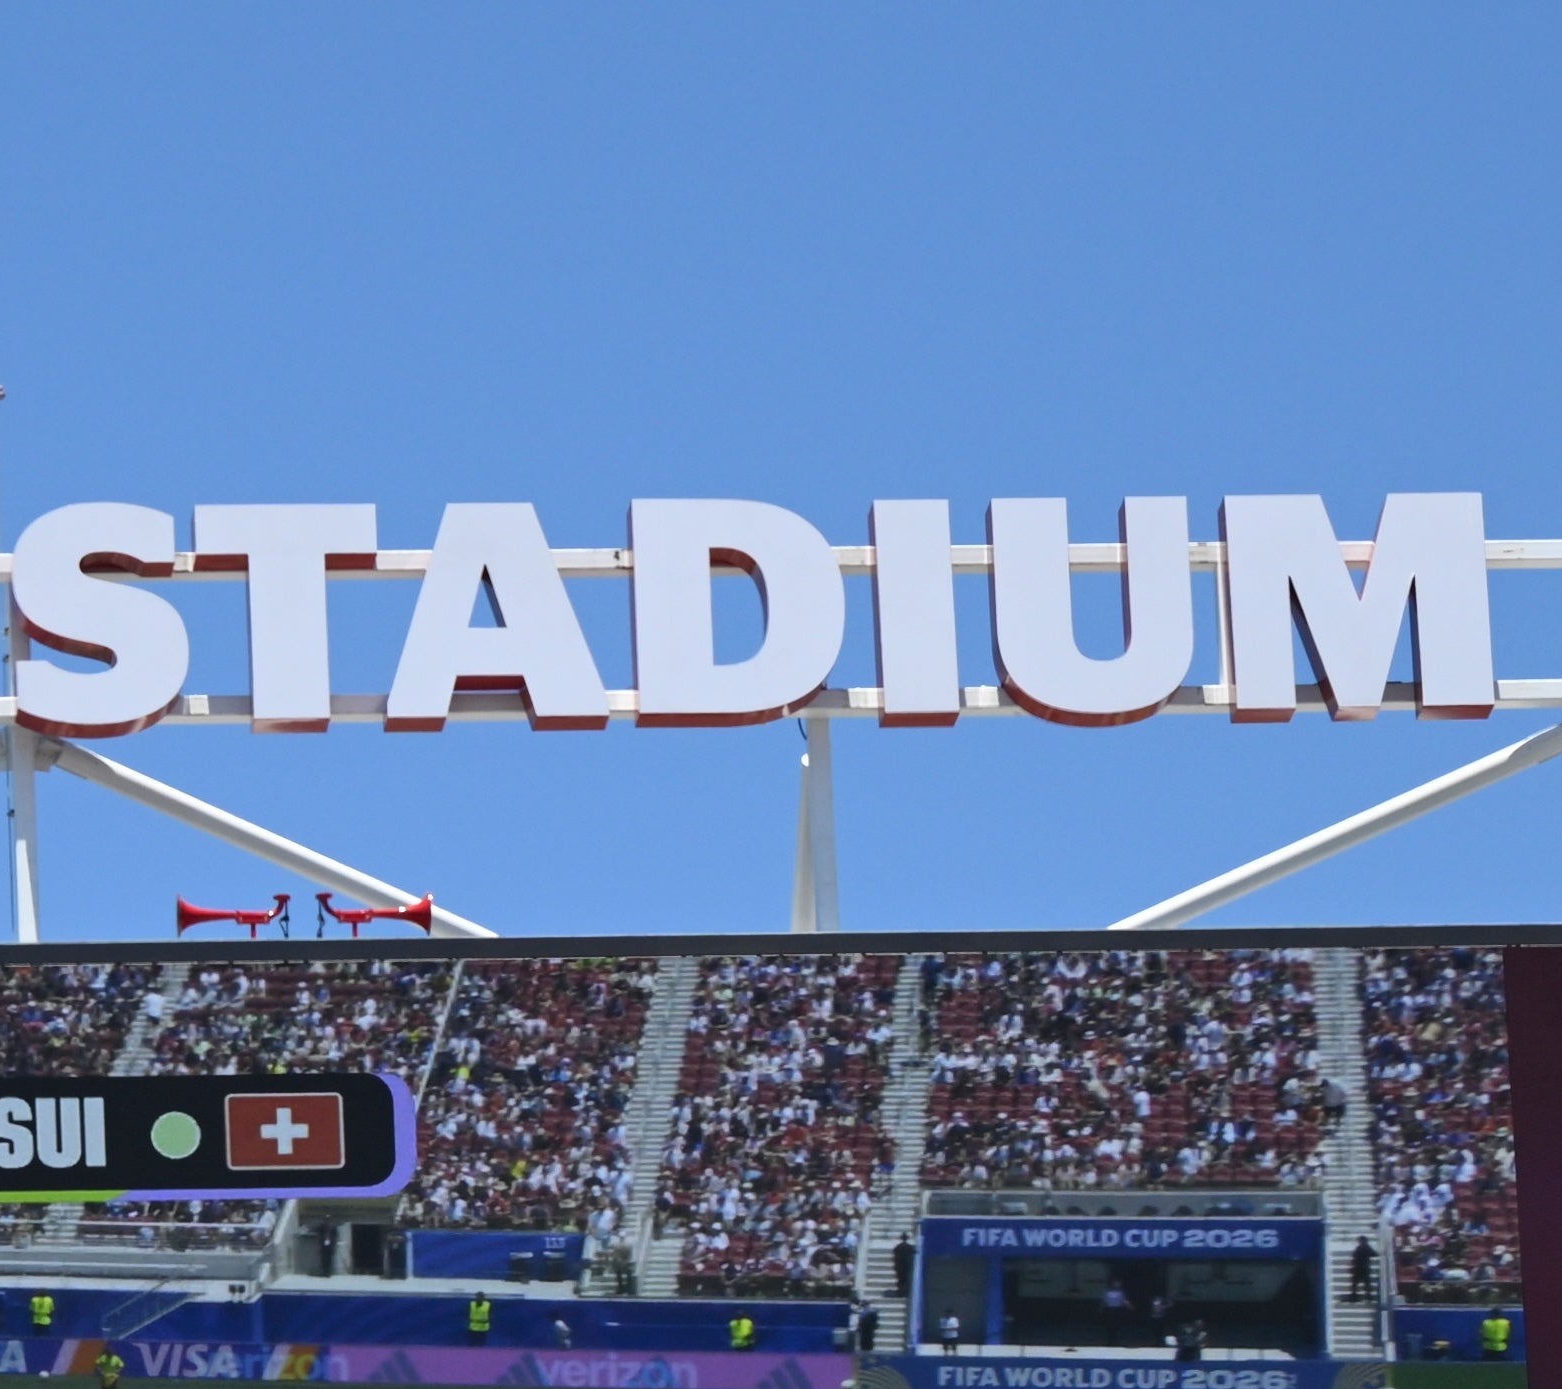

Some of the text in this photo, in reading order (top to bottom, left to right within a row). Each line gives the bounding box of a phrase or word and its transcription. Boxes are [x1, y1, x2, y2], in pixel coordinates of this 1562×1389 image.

[10, 490, 1495, 736] STADIUM
[962, 1228, 1280, 1248] FIFA WORLD CUP 2026
[134, 1342, 239, 1379] VISA
[537, 1352, 699, 1389] verizon
[938, 1366, 1000, 1387] FIFA
[1005, 1367, 1102, 1389] WORLD
[1117, 1368, 1178, 1389] CUP
